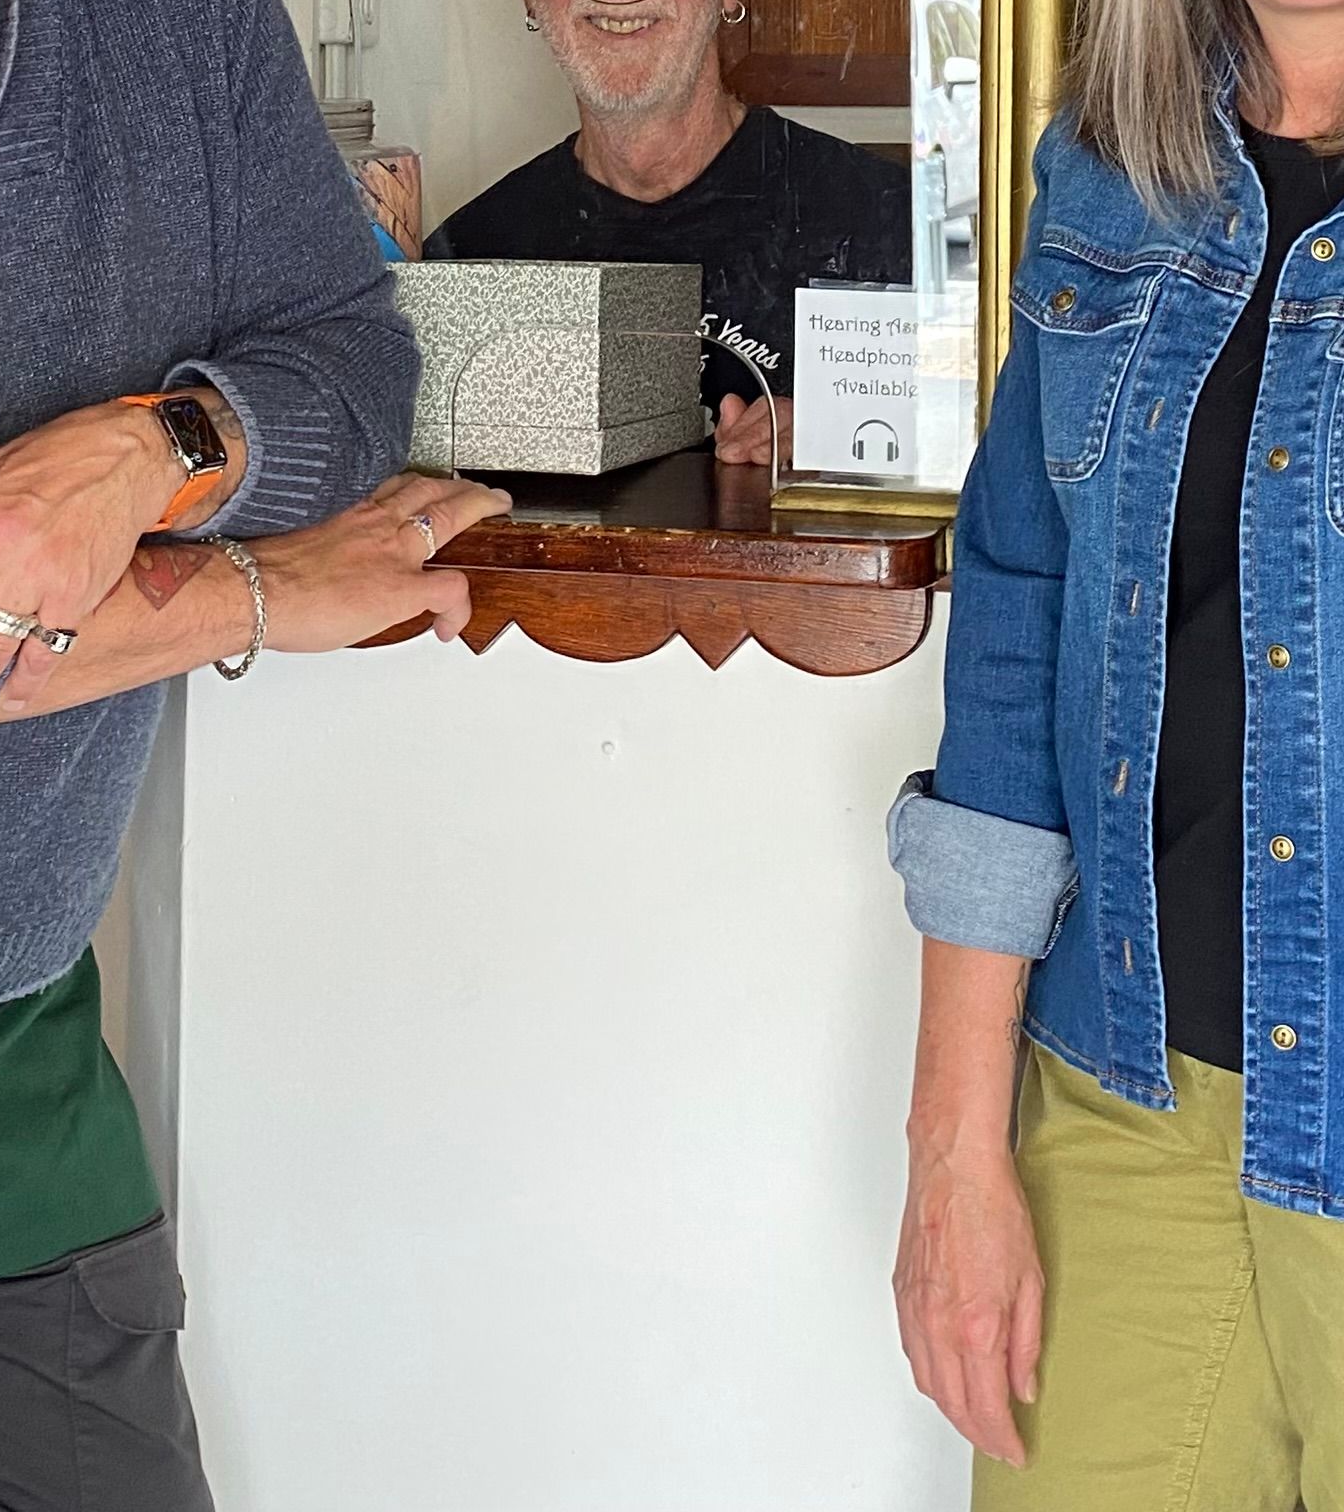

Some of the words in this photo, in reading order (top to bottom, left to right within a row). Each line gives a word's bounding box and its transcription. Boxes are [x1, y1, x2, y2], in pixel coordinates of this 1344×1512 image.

[809, 314, 881, 337] Hearing
[717, 319, 781, 370] Years
[833, 378, 920, 399] Available
